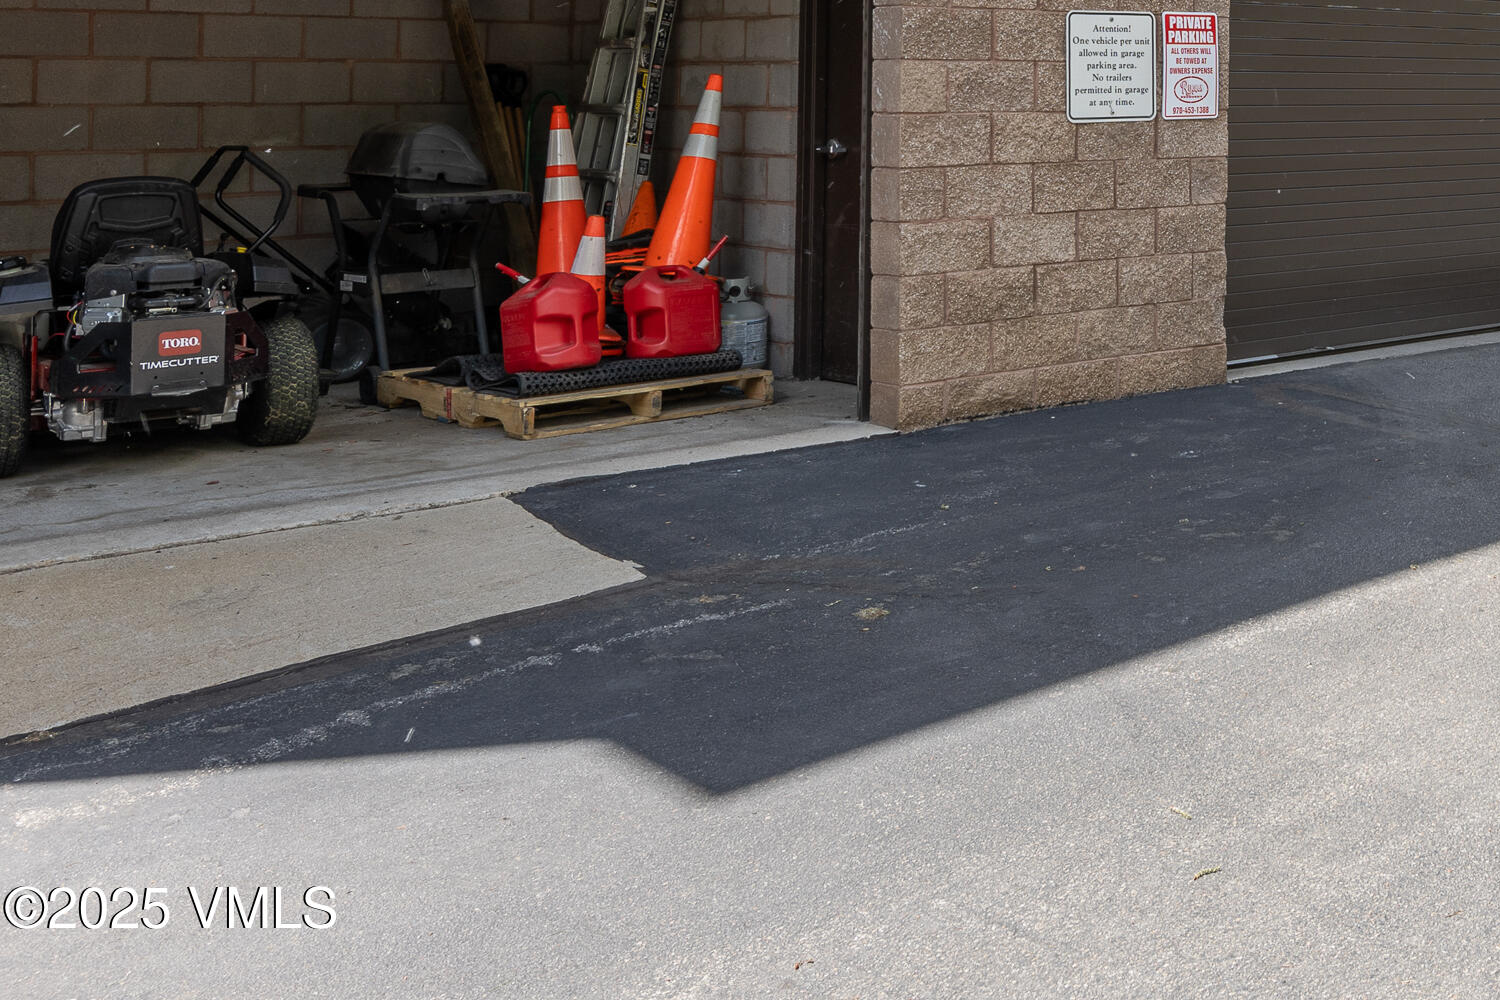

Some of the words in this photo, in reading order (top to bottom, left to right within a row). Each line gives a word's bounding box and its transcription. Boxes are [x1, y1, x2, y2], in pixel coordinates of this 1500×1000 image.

[1169, 16, 1212, 29] PRIVATE
[1072, 36, 1089, 44] One
[1092, 37, 1118, 45] vehicle
[1134, 37, 1150, 45] unit
[1168, 30, 1214, 43] PARKING
[1079, 49, 1108, 57] allowed
[1111, 49, 1118, 57] in
[1087, 61, 1116, 71] parking
[1075, 86, 1112, 96] permitted
[162, 336, 199, 348] TORO
[140, 355, 218, 370] TIMECUTTER
